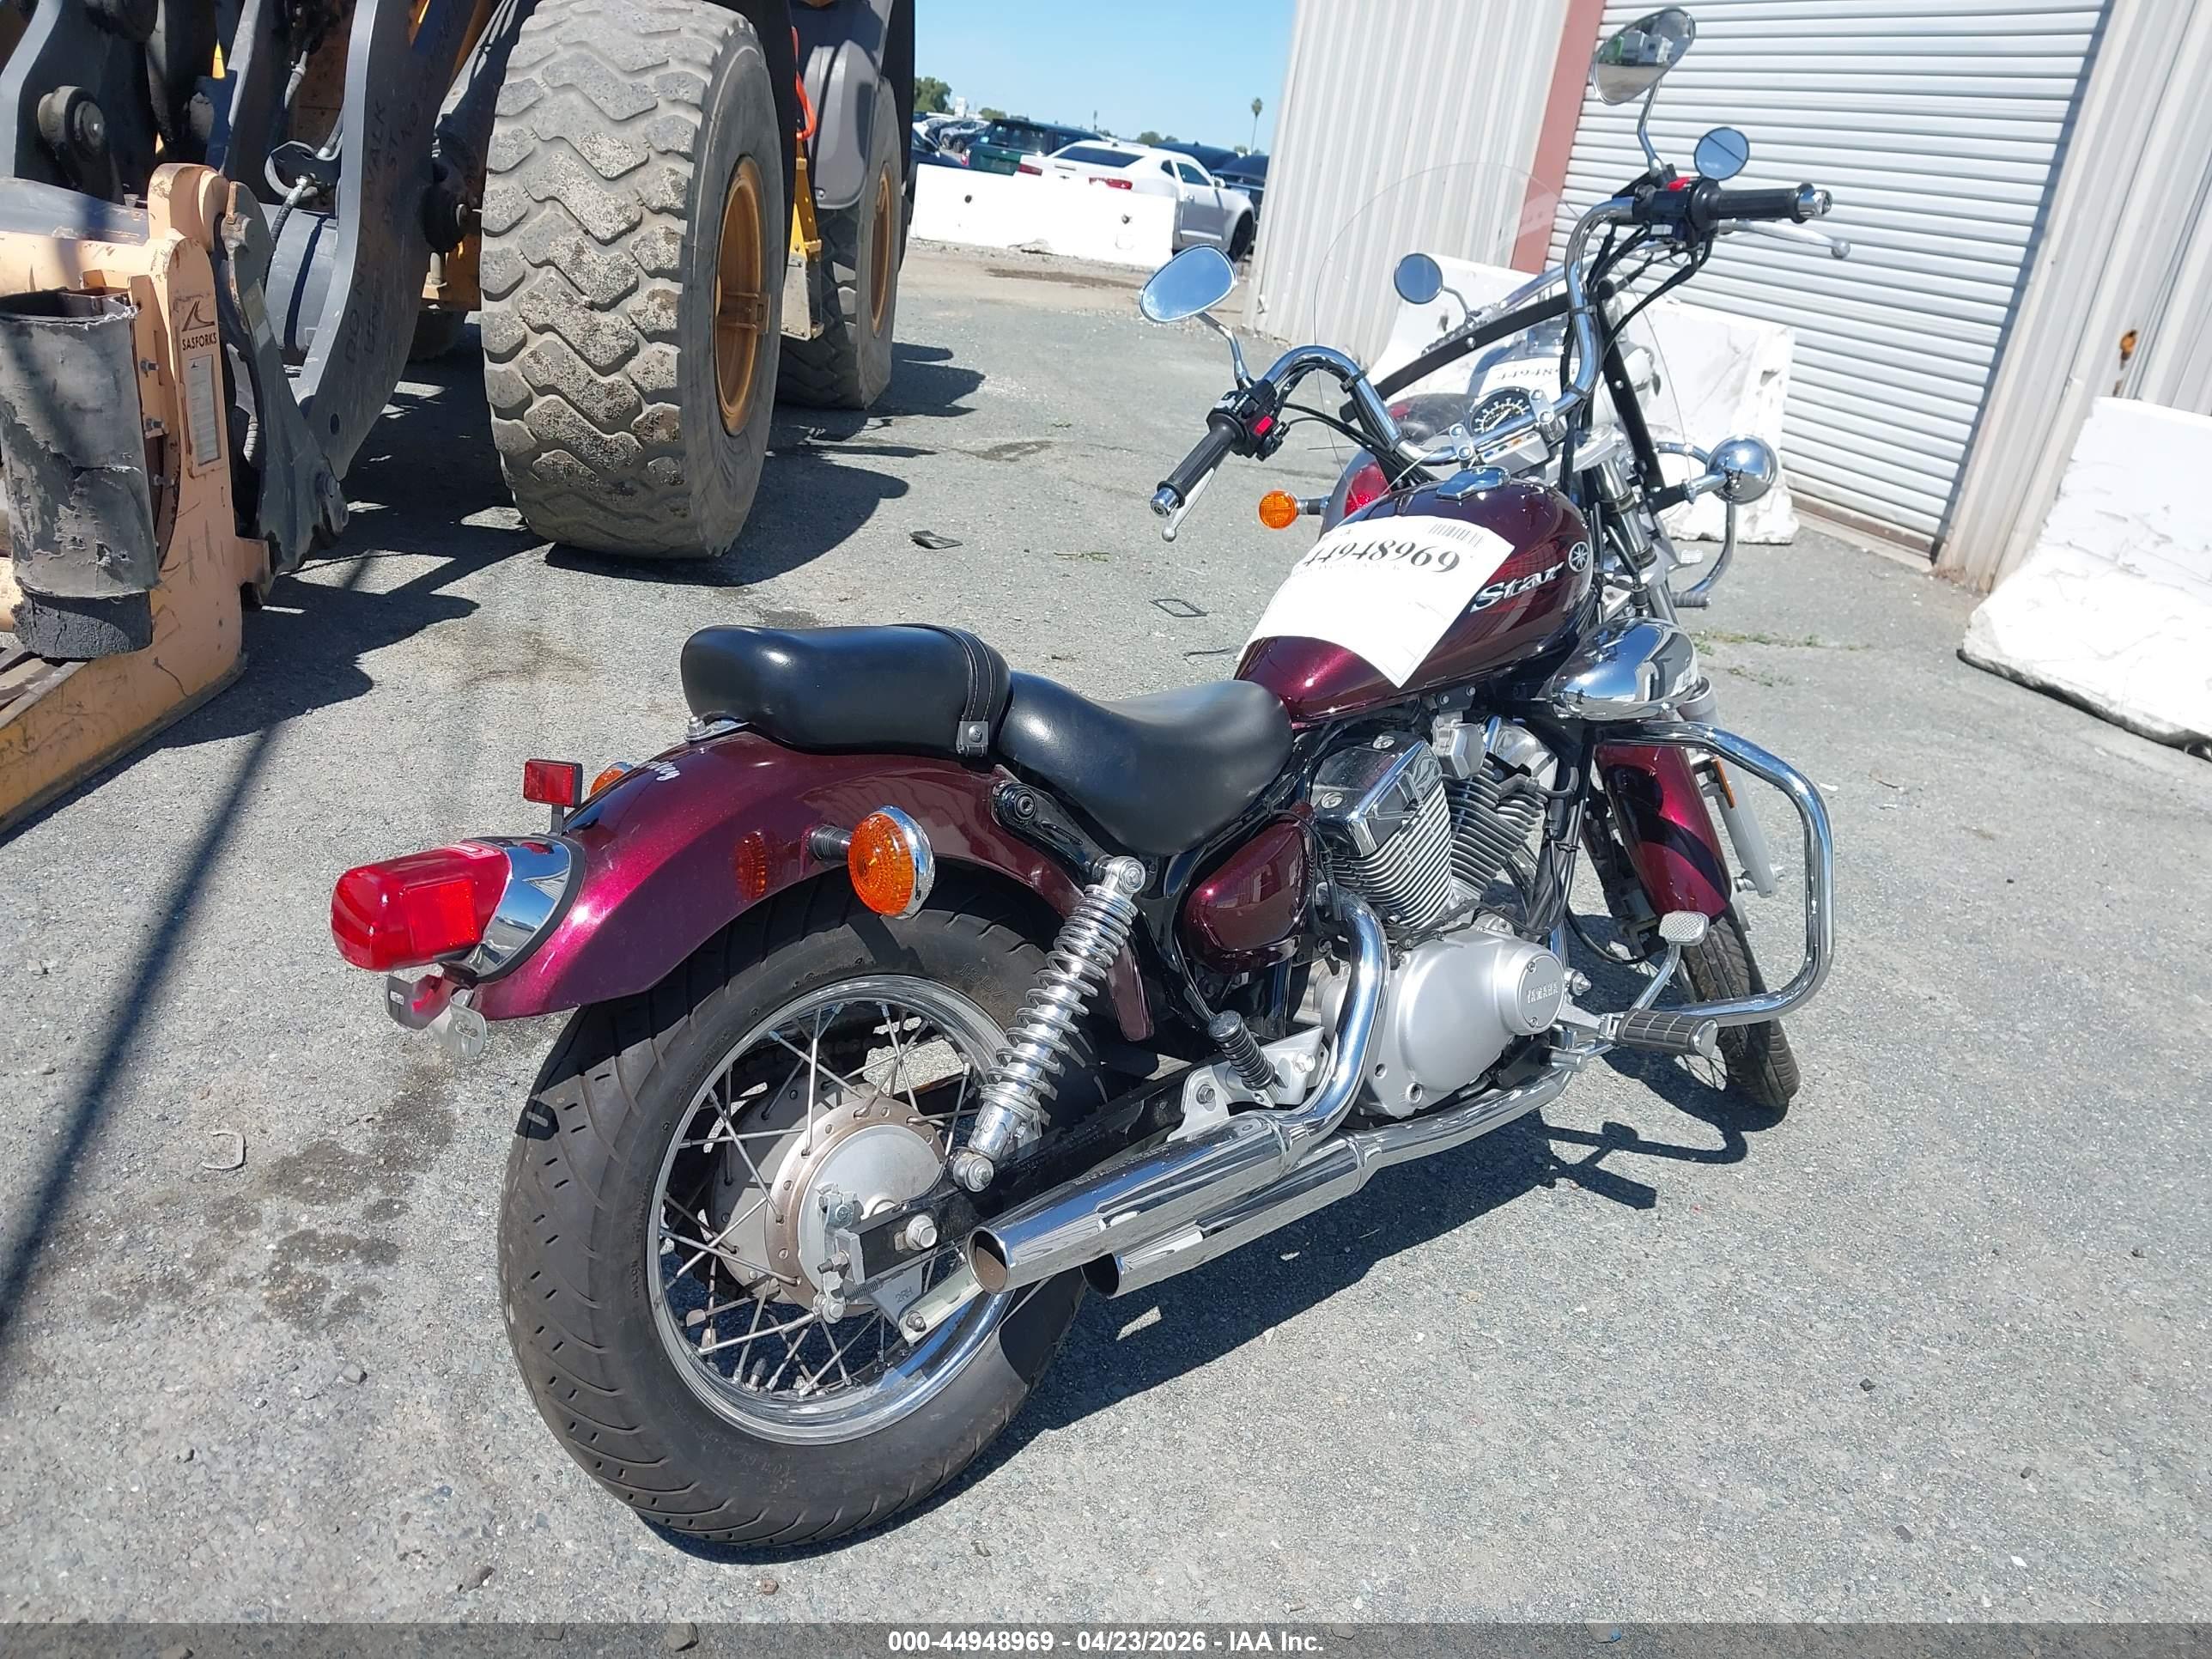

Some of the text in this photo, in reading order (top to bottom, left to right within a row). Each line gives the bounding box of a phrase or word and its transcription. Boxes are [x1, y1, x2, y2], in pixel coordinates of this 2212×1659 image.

[182, 332, 217, 350] SASFORKS
[1469, 561, 1565, 613] Star
[1526, 981, 1559, 1004] YAMAHA
